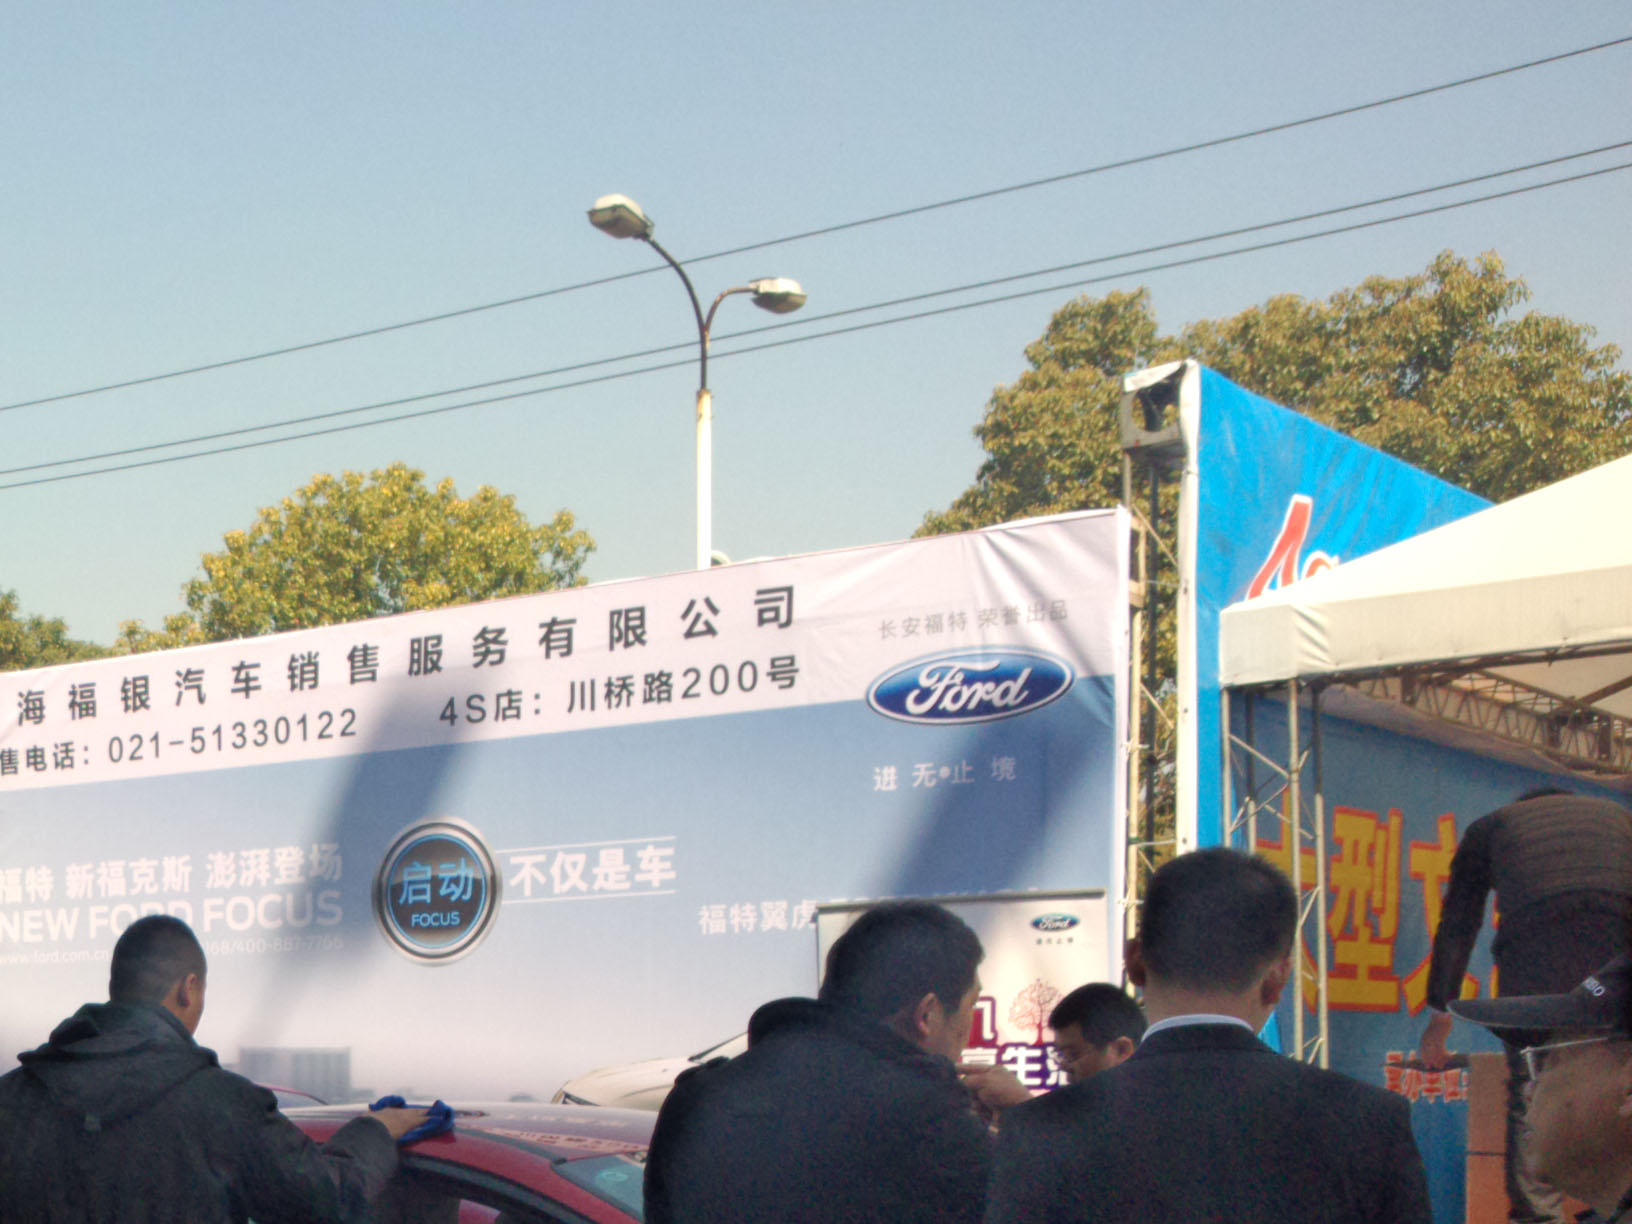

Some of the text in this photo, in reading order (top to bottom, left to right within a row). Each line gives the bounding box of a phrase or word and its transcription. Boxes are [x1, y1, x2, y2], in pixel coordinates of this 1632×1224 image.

[905, 658, 1032, 715] Ford
[65, 854, 192, 899] 新福克斯
[206, 843, 343, 889] 澎湃登场
[399, 857, 474, 905] 启动
[509, 846, 677, 897] 不仅是车
[203, 890, 344, 934] FOCUS
[411, 911, 461, 927] FOCUS
